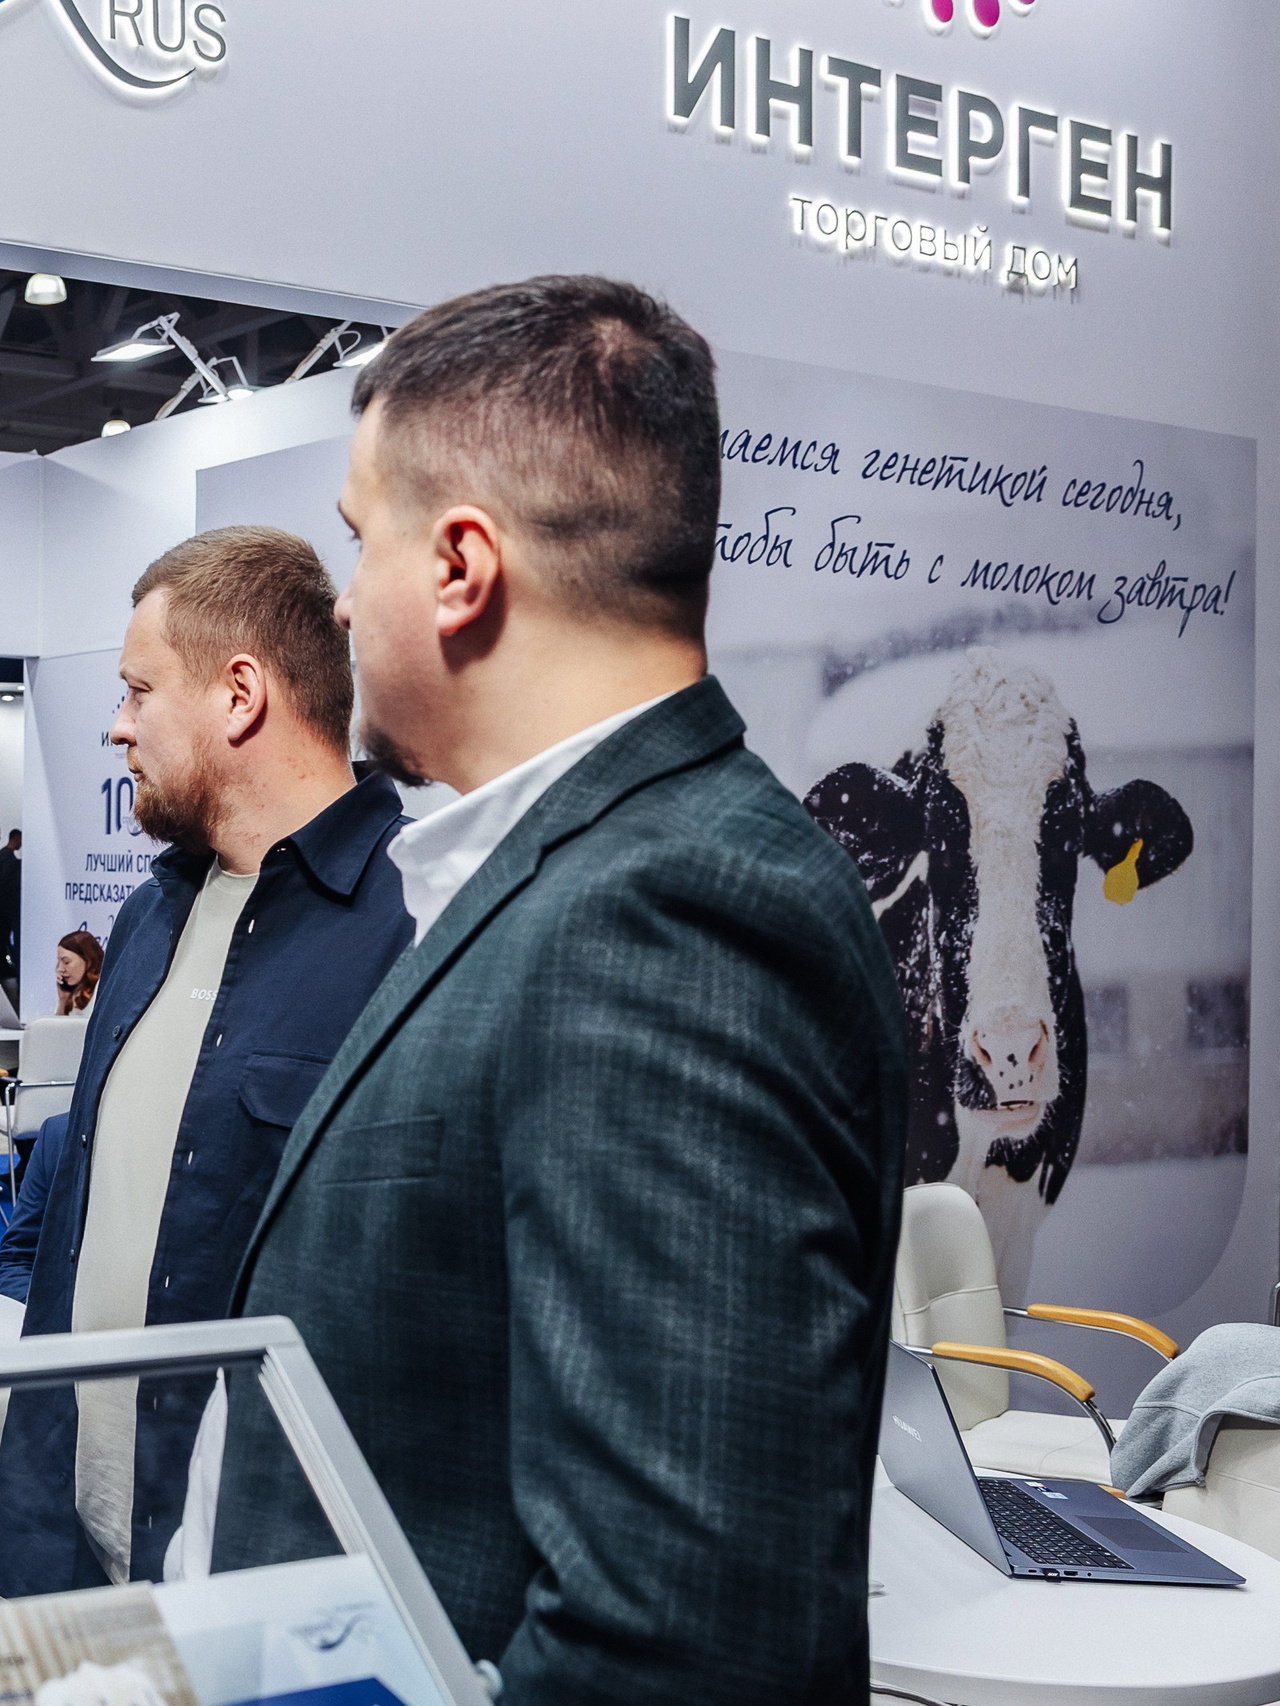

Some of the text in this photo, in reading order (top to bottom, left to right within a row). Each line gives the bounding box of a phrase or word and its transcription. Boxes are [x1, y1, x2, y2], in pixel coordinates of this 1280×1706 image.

[110, 0, 227, 62] RUS
[672, 15, 1172, 231] ИНТЕРГЕН
[1006, 244, 1079, 290] дом
[861, 449, 1047, 507] генетикой
[1062, 459, 1181, 531] сегодня,
[814, 515, 910, 580] быть
[928, 554, 944, 584] с
[960, 559, 1096, 605] молоком
[1097, 560, 1236, 638] завтра!
[85, 849, 133, 873] ЛУЧШИЙ
[190, 988, 218, 1000] BOSS
